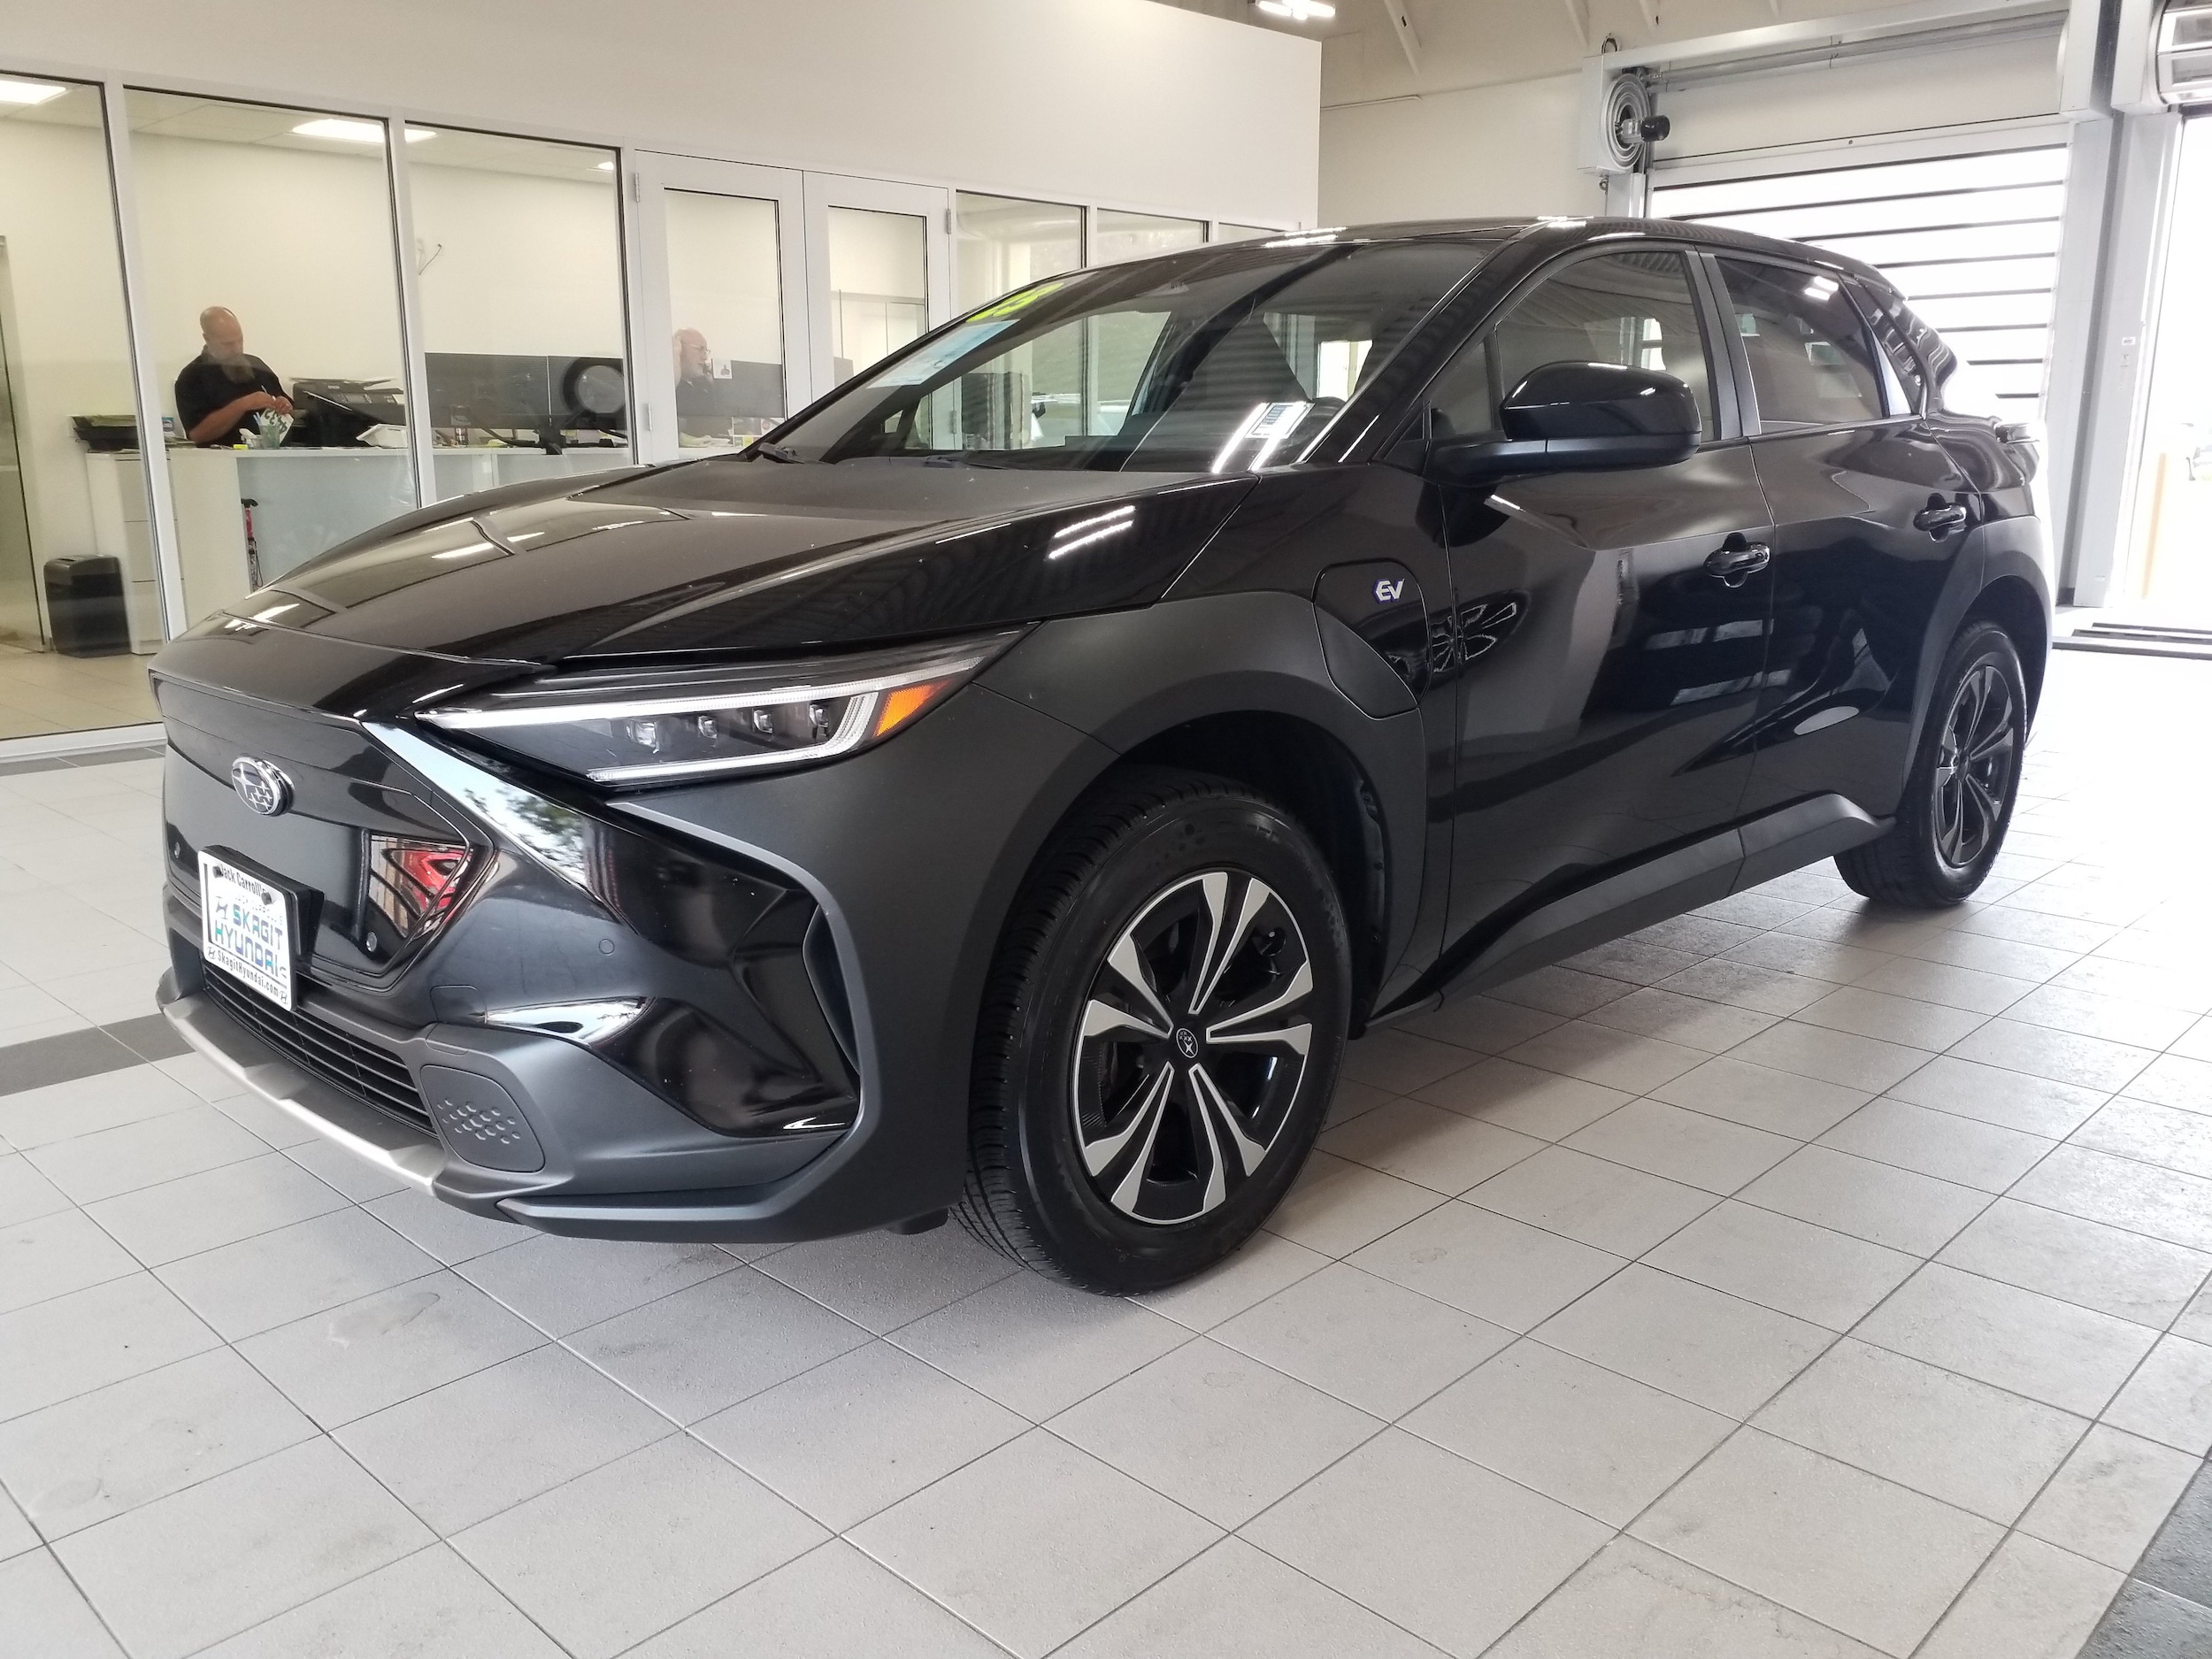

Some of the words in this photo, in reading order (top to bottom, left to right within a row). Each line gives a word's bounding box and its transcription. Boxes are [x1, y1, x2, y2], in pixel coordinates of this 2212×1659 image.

[1372, 578, 1406, 603] EV
[219, 863, 236, 884] Jack
[215, 919, 279, 978] HYUNDAI
[233, 903, 283, 950] SKAGIT
[217, 949, 279, 997] SkagitHyundai.com
